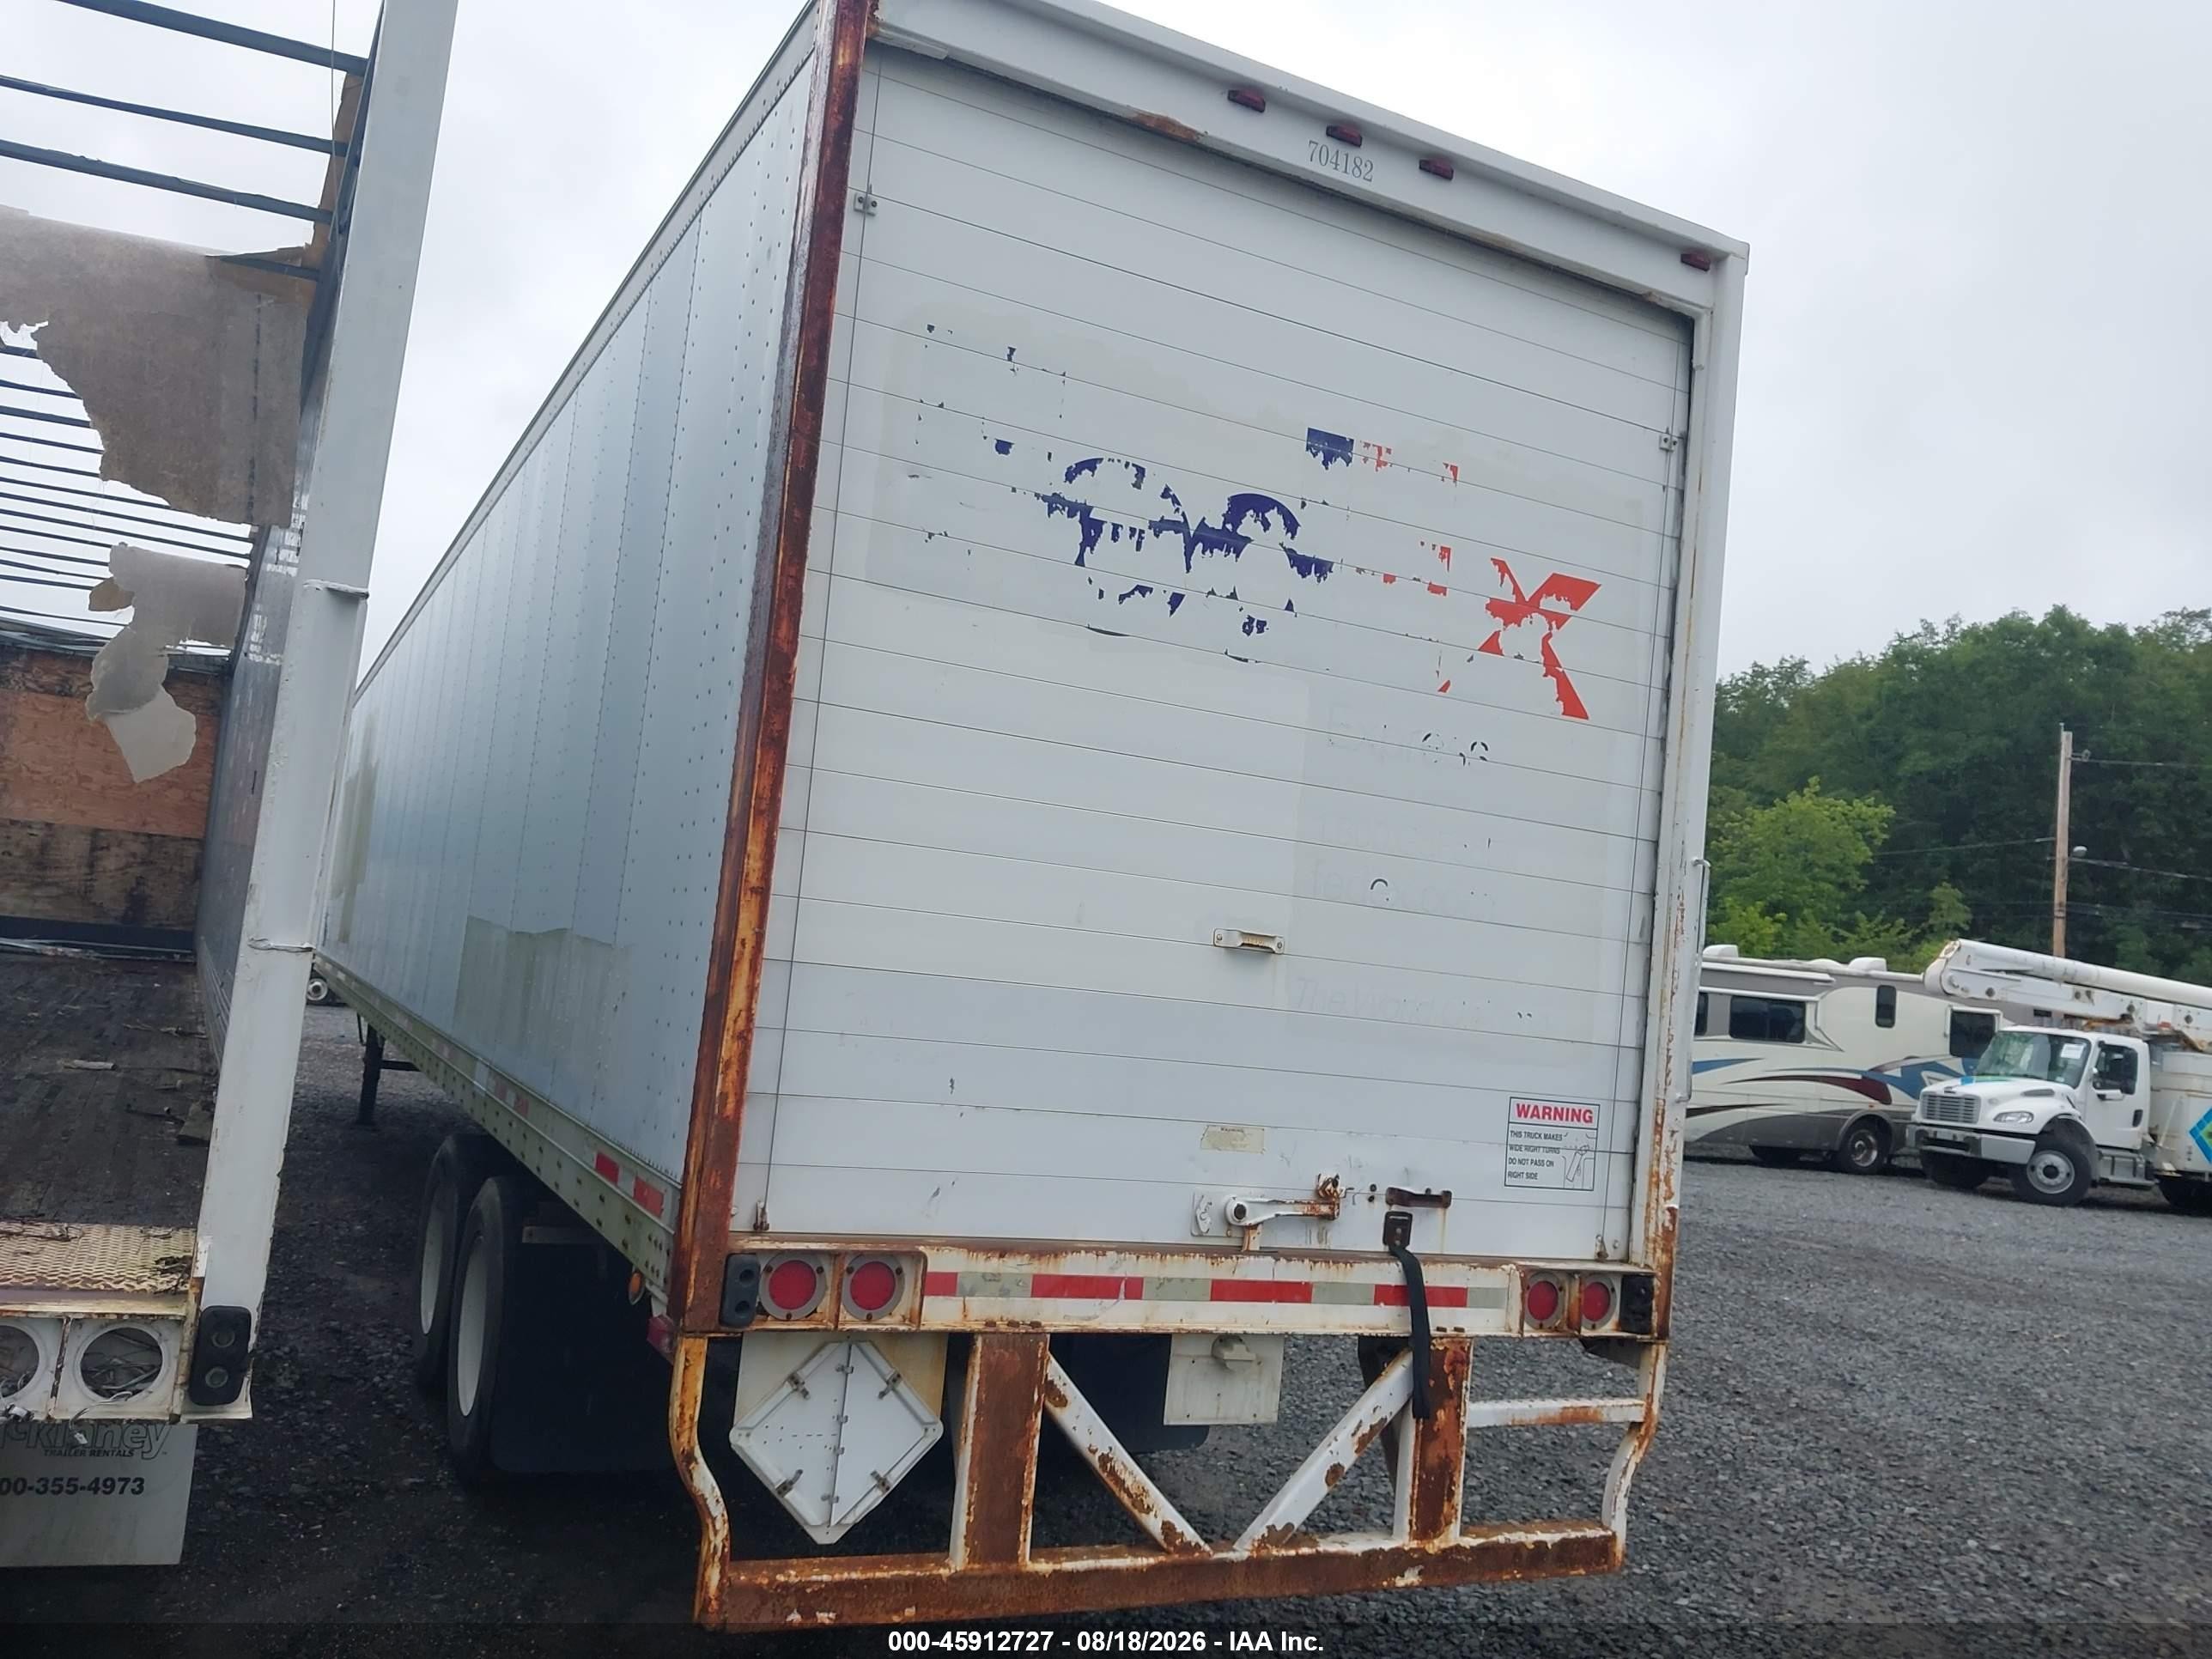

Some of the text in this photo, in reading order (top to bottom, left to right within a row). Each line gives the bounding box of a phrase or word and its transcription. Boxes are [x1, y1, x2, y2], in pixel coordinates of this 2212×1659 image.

[1308, 140, 1374, 182] 704182
[1516, 1103, 1594, 1124] WARNING
[1524, 1131, 1542, 1139] TRUCK
[1543, 1133, 1563, 1141] MAKES
[1508, 1157, 1554, 1168] DO NOT PASS ON
[1507, 1170, 1524, 1179] RIGHT
[44, 1449, 134, 1457] TRAILER RENTALS
